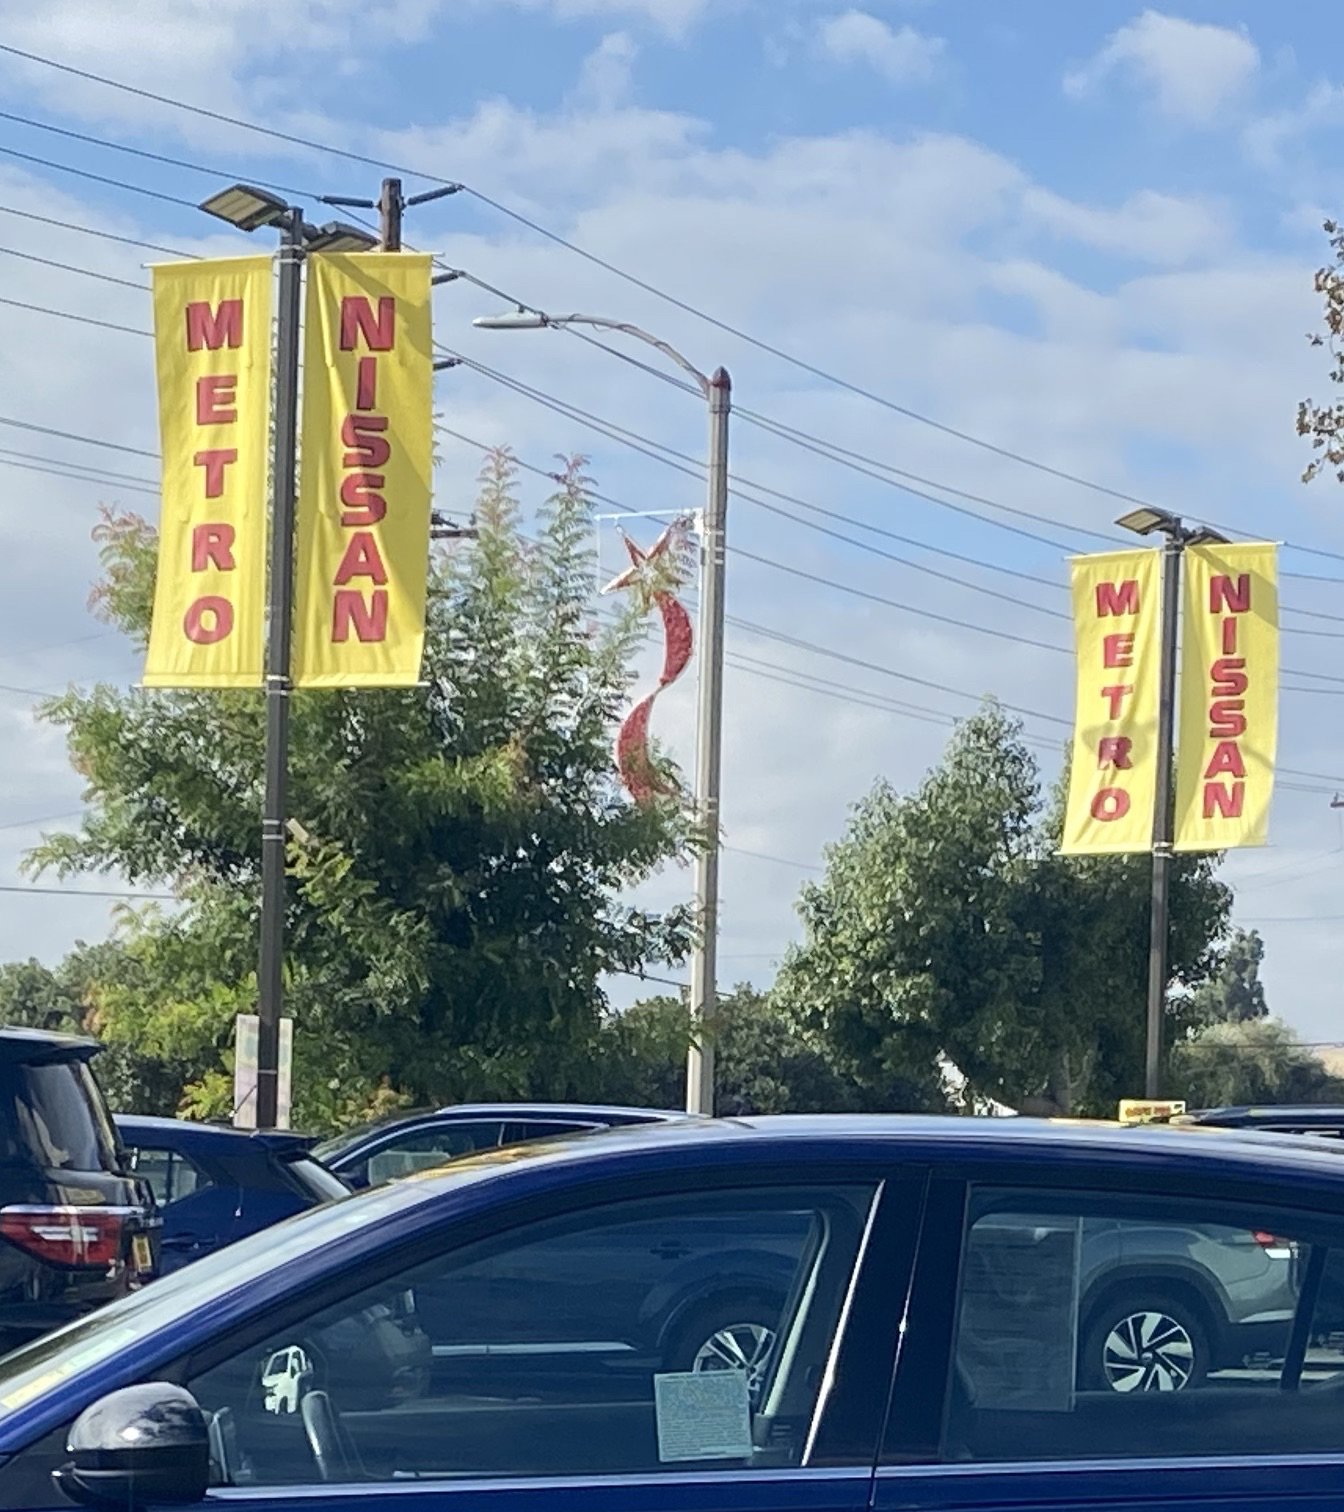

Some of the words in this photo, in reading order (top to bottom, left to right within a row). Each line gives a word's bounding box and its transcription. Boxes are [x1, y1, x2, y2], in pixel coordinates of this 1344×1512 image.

[183, 298, 244, 646] METRO
[331, 295, 396, 644] NISSAN
[1090, 580, 1141, 822] METRO
[1202, 573, 1252, 819] NISSAN
